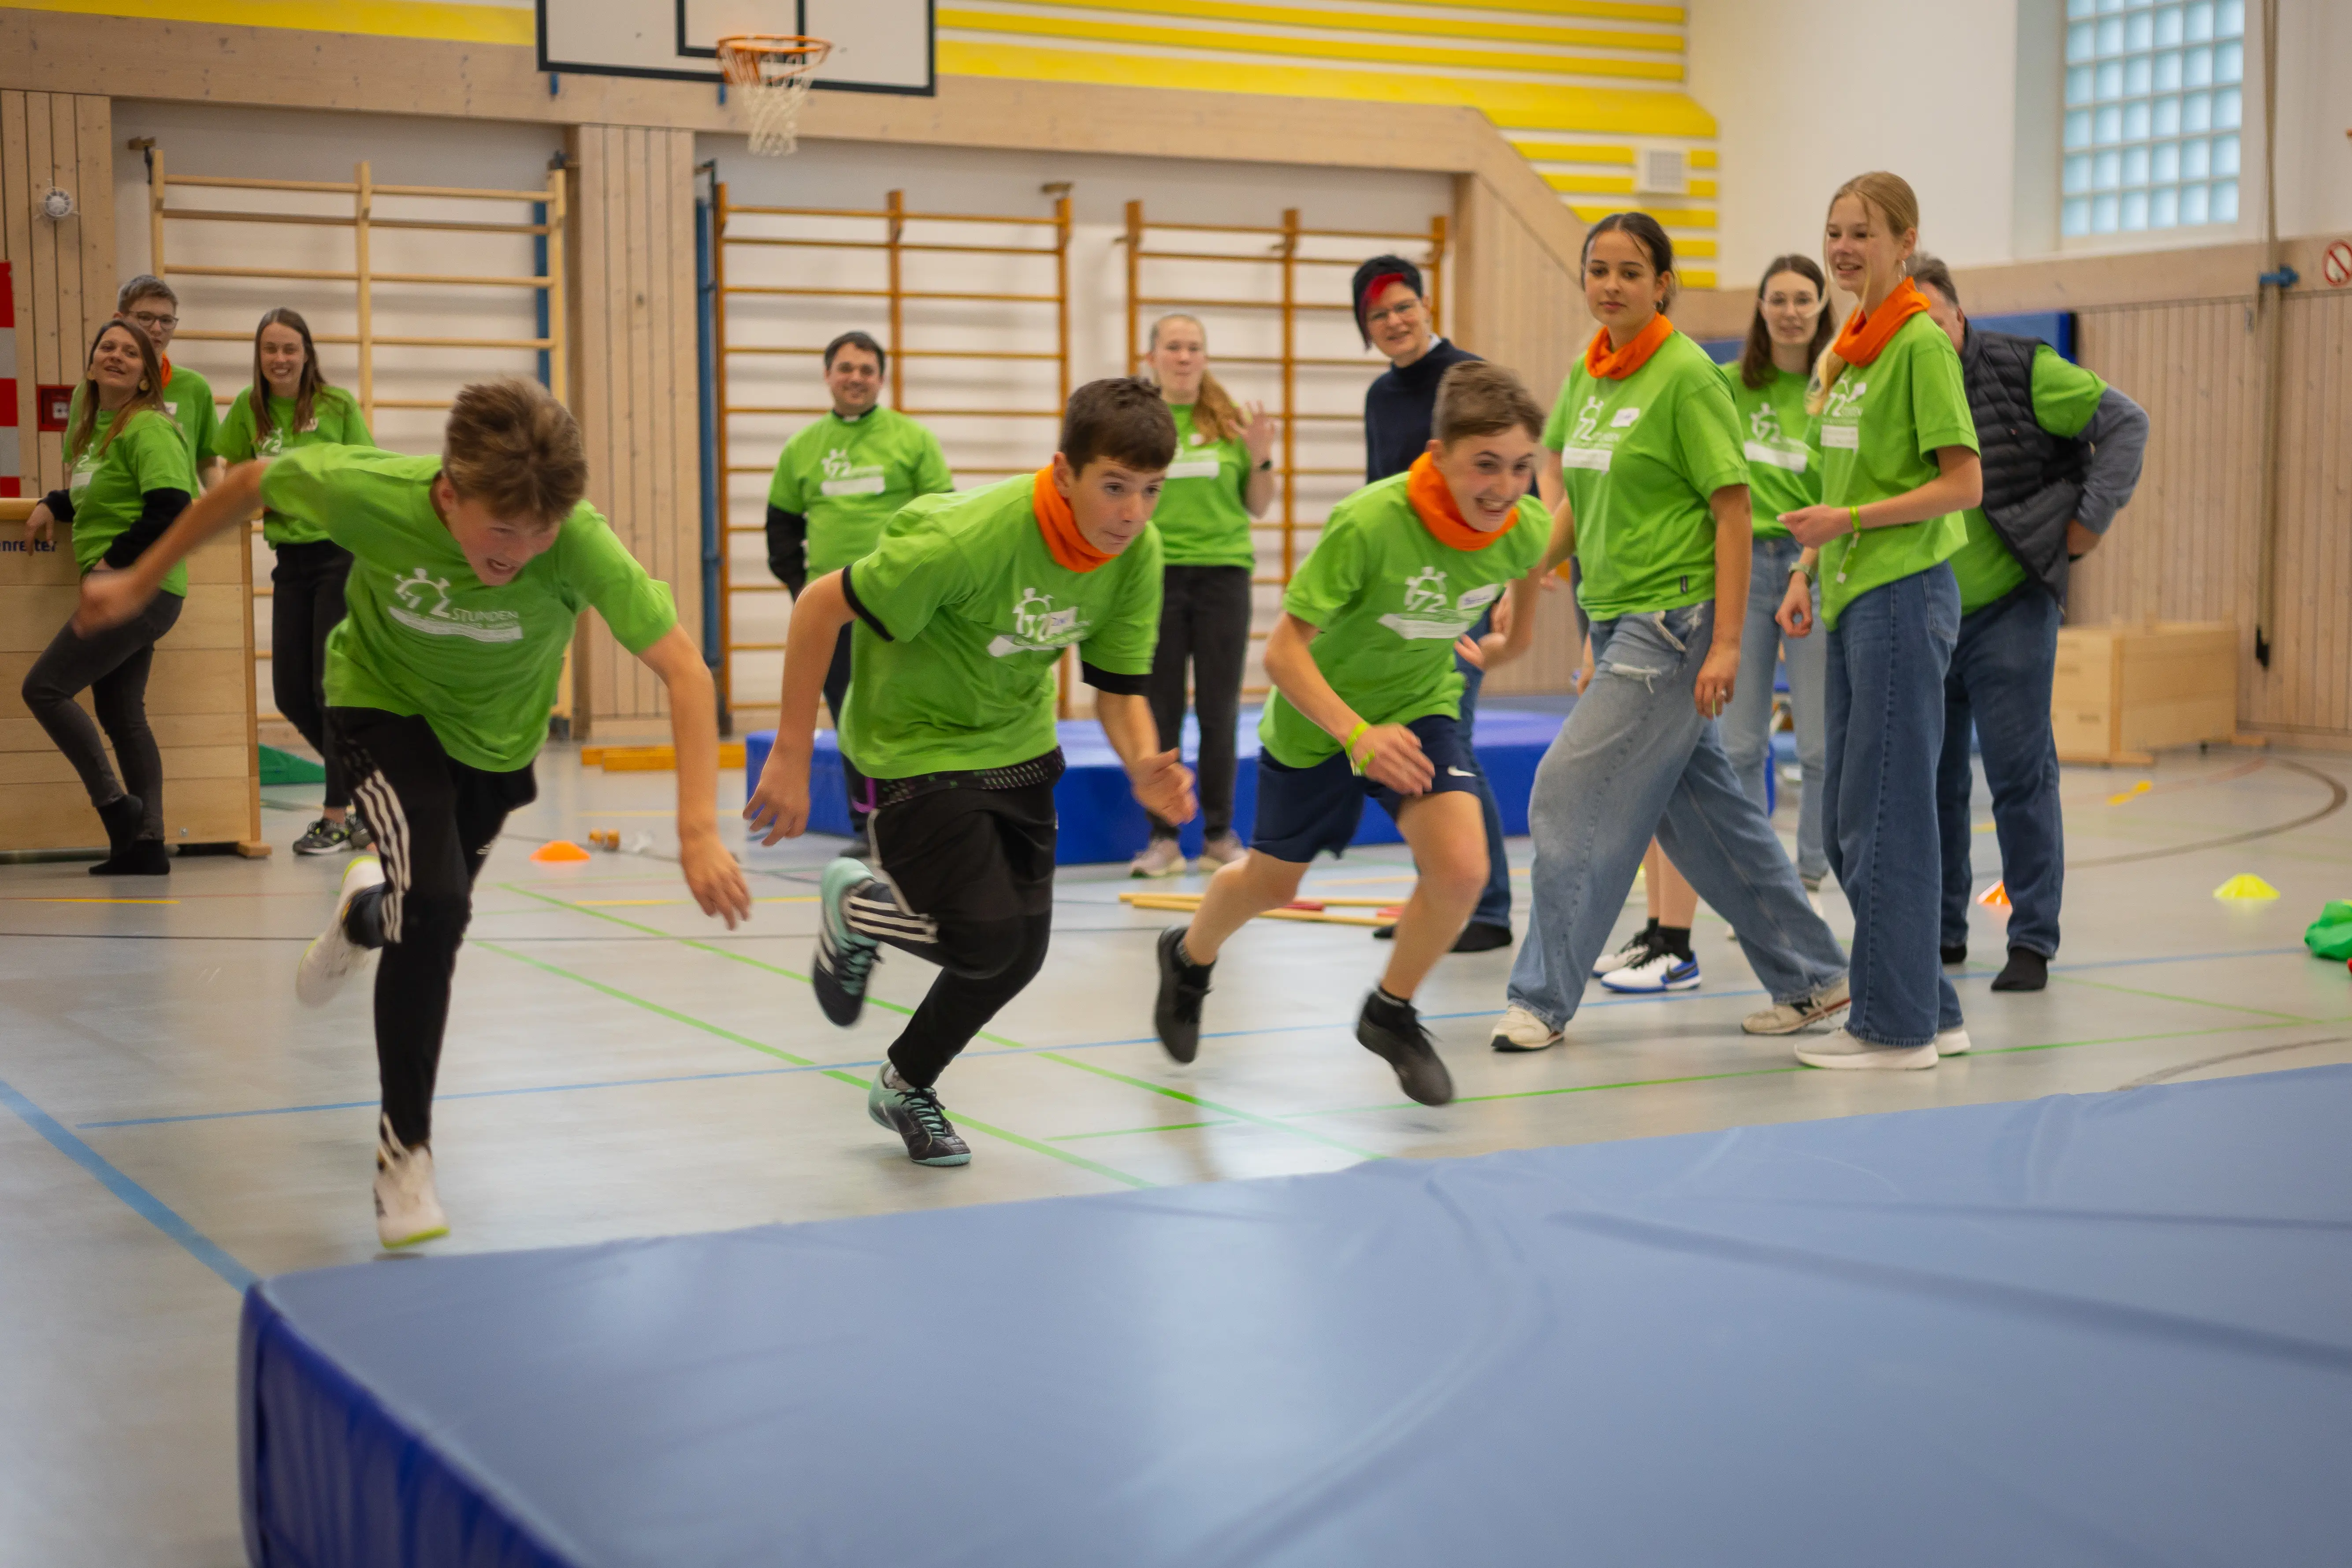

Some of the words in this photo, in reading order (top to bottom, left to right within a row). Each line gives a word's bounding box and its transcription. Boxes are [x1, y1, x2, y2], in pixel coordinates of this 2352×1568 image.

[1823, 392, 1846, 417] 72
[1572, 416, 1596, 440] 72
[830, 462, 851, 478] 72
[0, 539, 57, 551] nreter
[1407, 589, 1447, 613] 72
